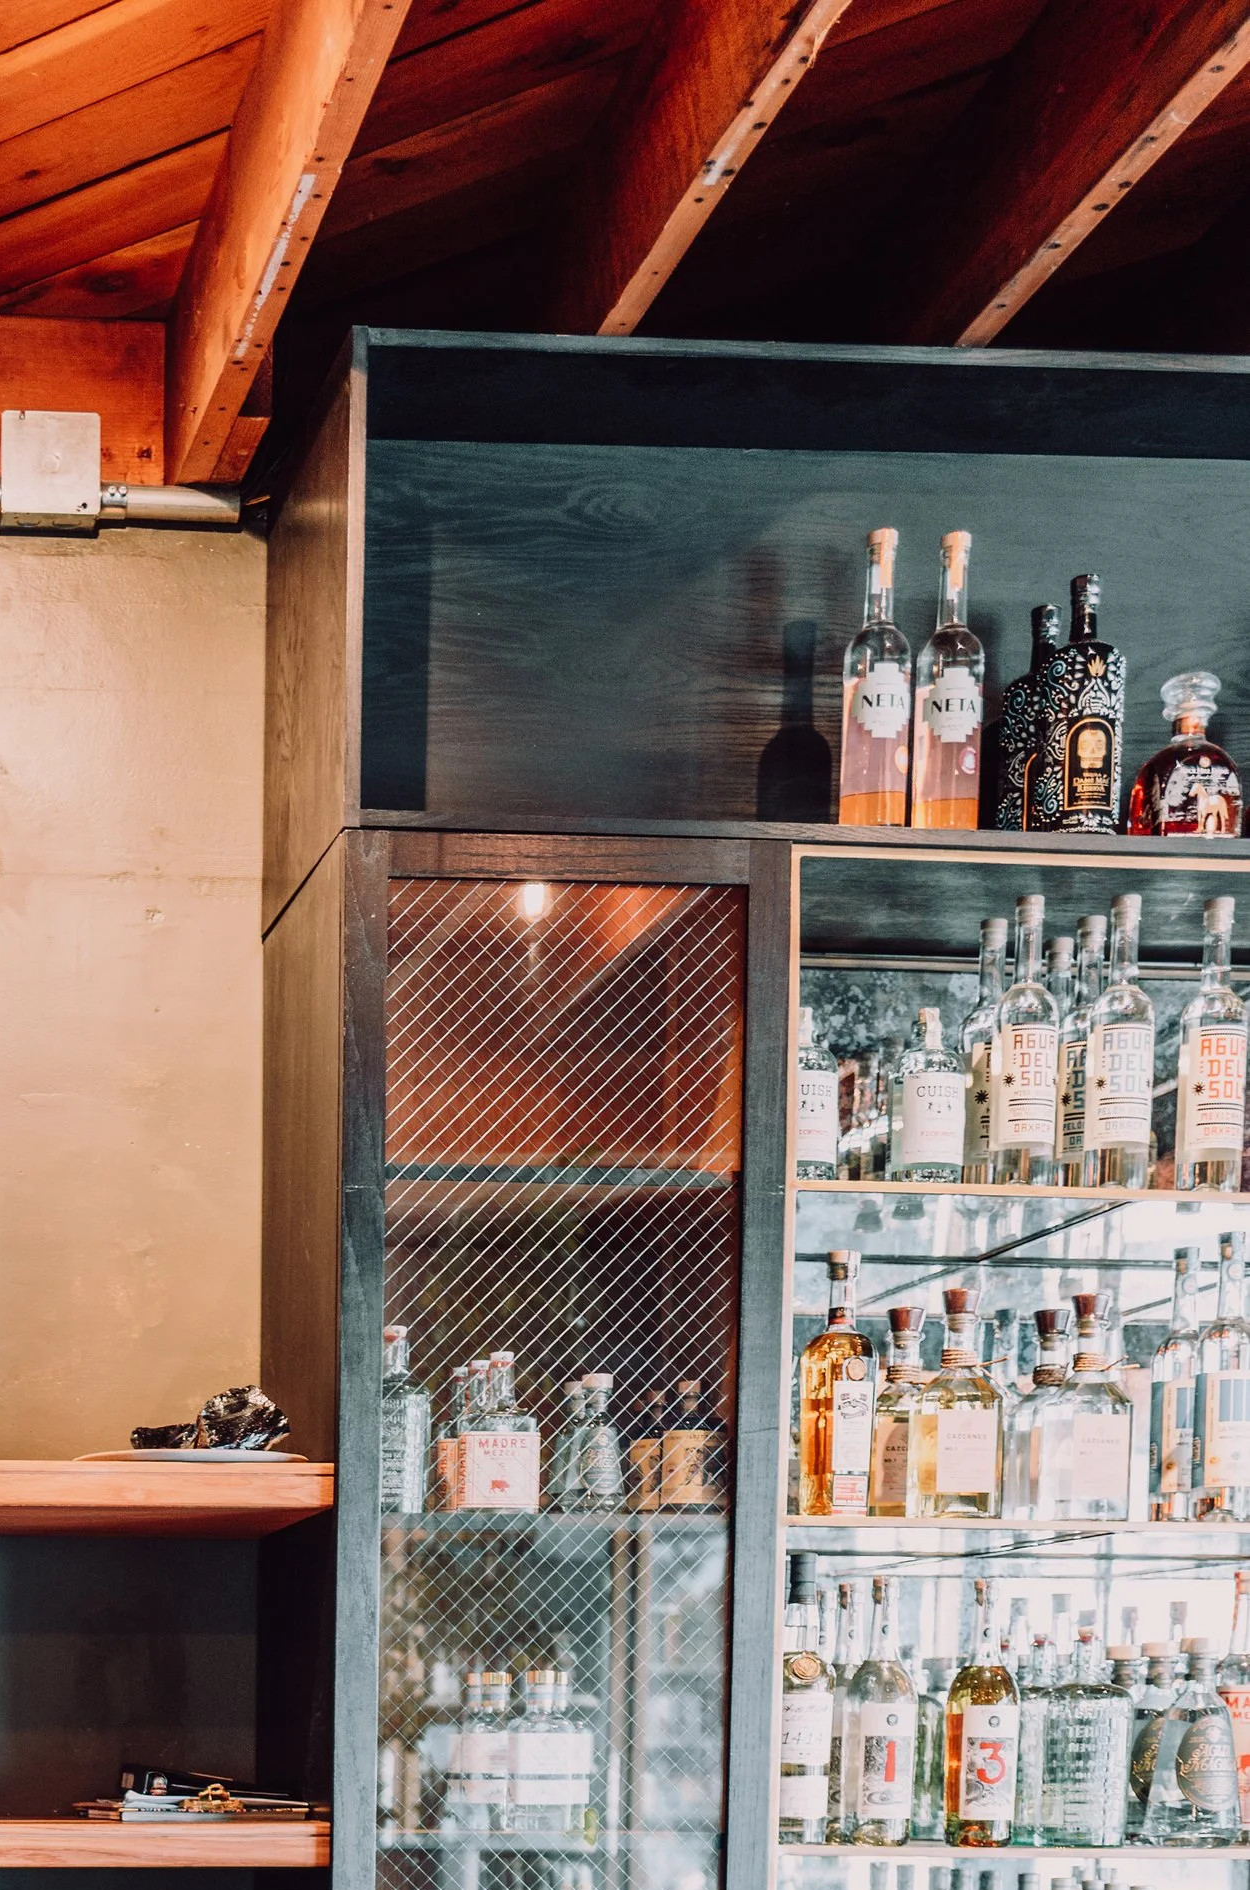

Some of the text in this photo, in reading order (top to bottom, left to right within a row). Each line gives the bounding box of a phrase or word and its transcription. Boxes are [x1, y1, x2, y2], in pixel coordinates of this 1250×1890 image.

[862, 693, 905, 709] NETA
[931, 698, 976, 714] NETA
[1020, 1052, 1051, 1068] DEL
[1108, 1054, 1146, 1072] DEL
[1208, 1059, 1242, 1078] DEL
[1021, 1071, 1051, 1087] SOL
[1110, 1075, 1146, 1093] SOL
[801, 1084, 832, 1098] UISH
[916, 1085, 959, 1098] CUISH
[1209, 1080, 1242, 1099] SOL
[478, 1438, 528, 1449] MADRE
[884, 1741, 897, 1783] 1
[976, 1741, 1007, 1784] 3
